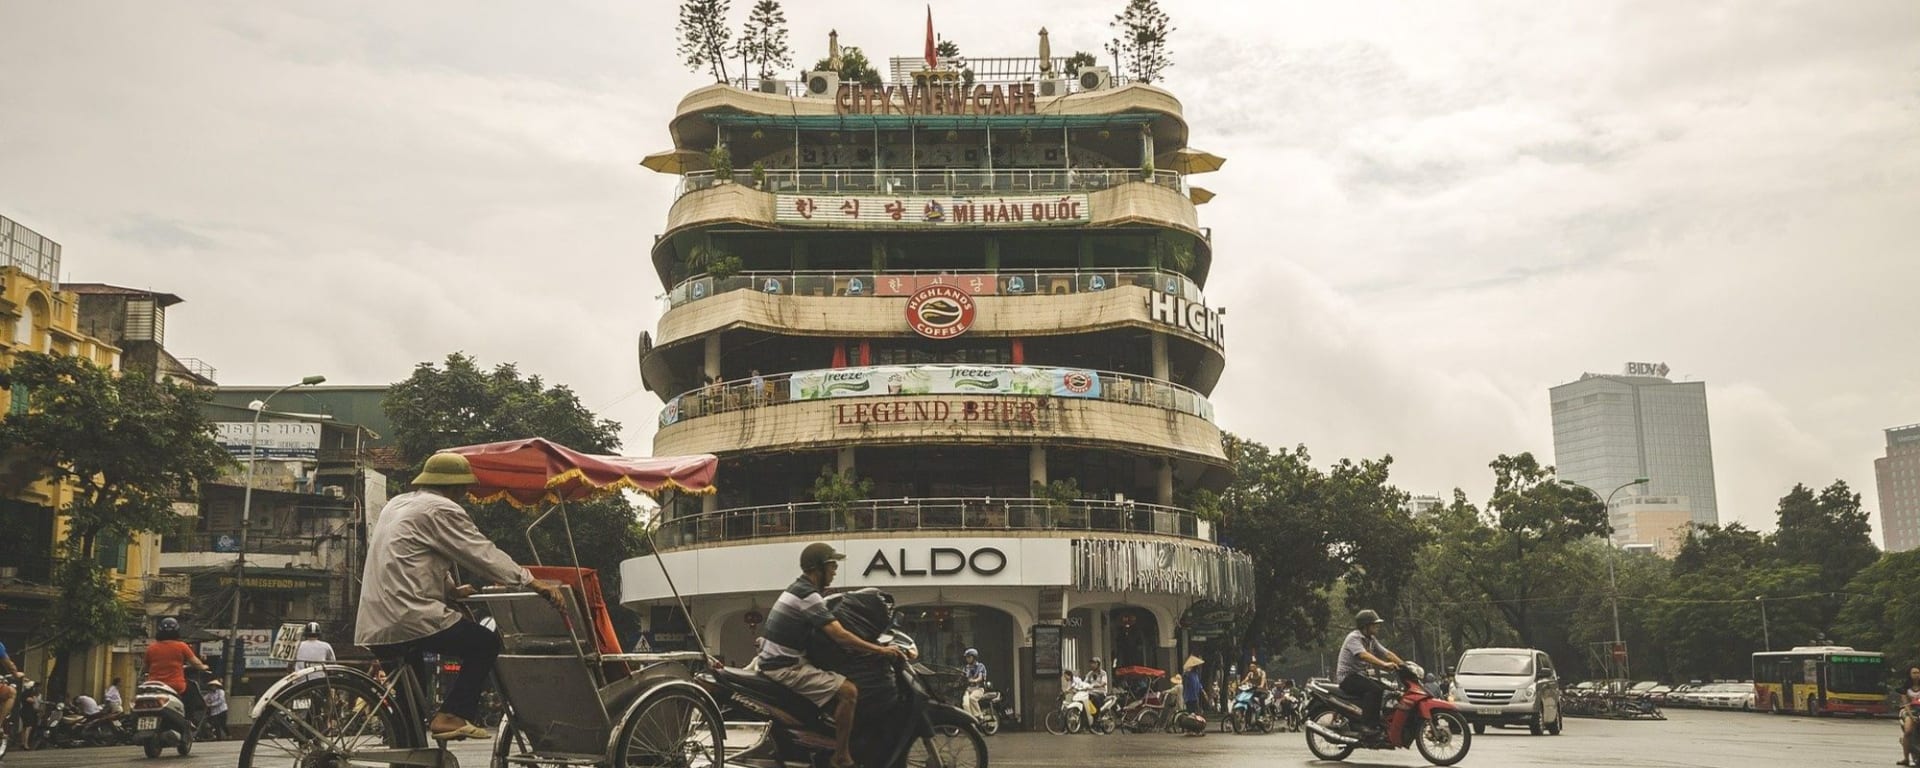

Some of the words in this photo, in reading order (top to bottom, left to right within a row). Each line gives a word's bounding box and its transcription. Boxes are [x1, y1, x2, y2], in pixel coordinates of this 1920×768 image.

[836, 85, 894, 115] CITY
[900, 84, 968, 115] VIEW
[983, 198, 1024, 222] HÀN
[1031, 195, 1081, 222] QUỐC
[909, 288, 972, 310] HIGHLANDS
[917, 322, 965, 336] COFFEE
[1628, 362, 1657, 376] BIDV
[836, 400, 949, 425] LEGEND
[963, 400, 1038, 425] BEER
[862, 547, 1008, 577] ALDO
[1136, 568, 1191, 583] SWAROVSKI
